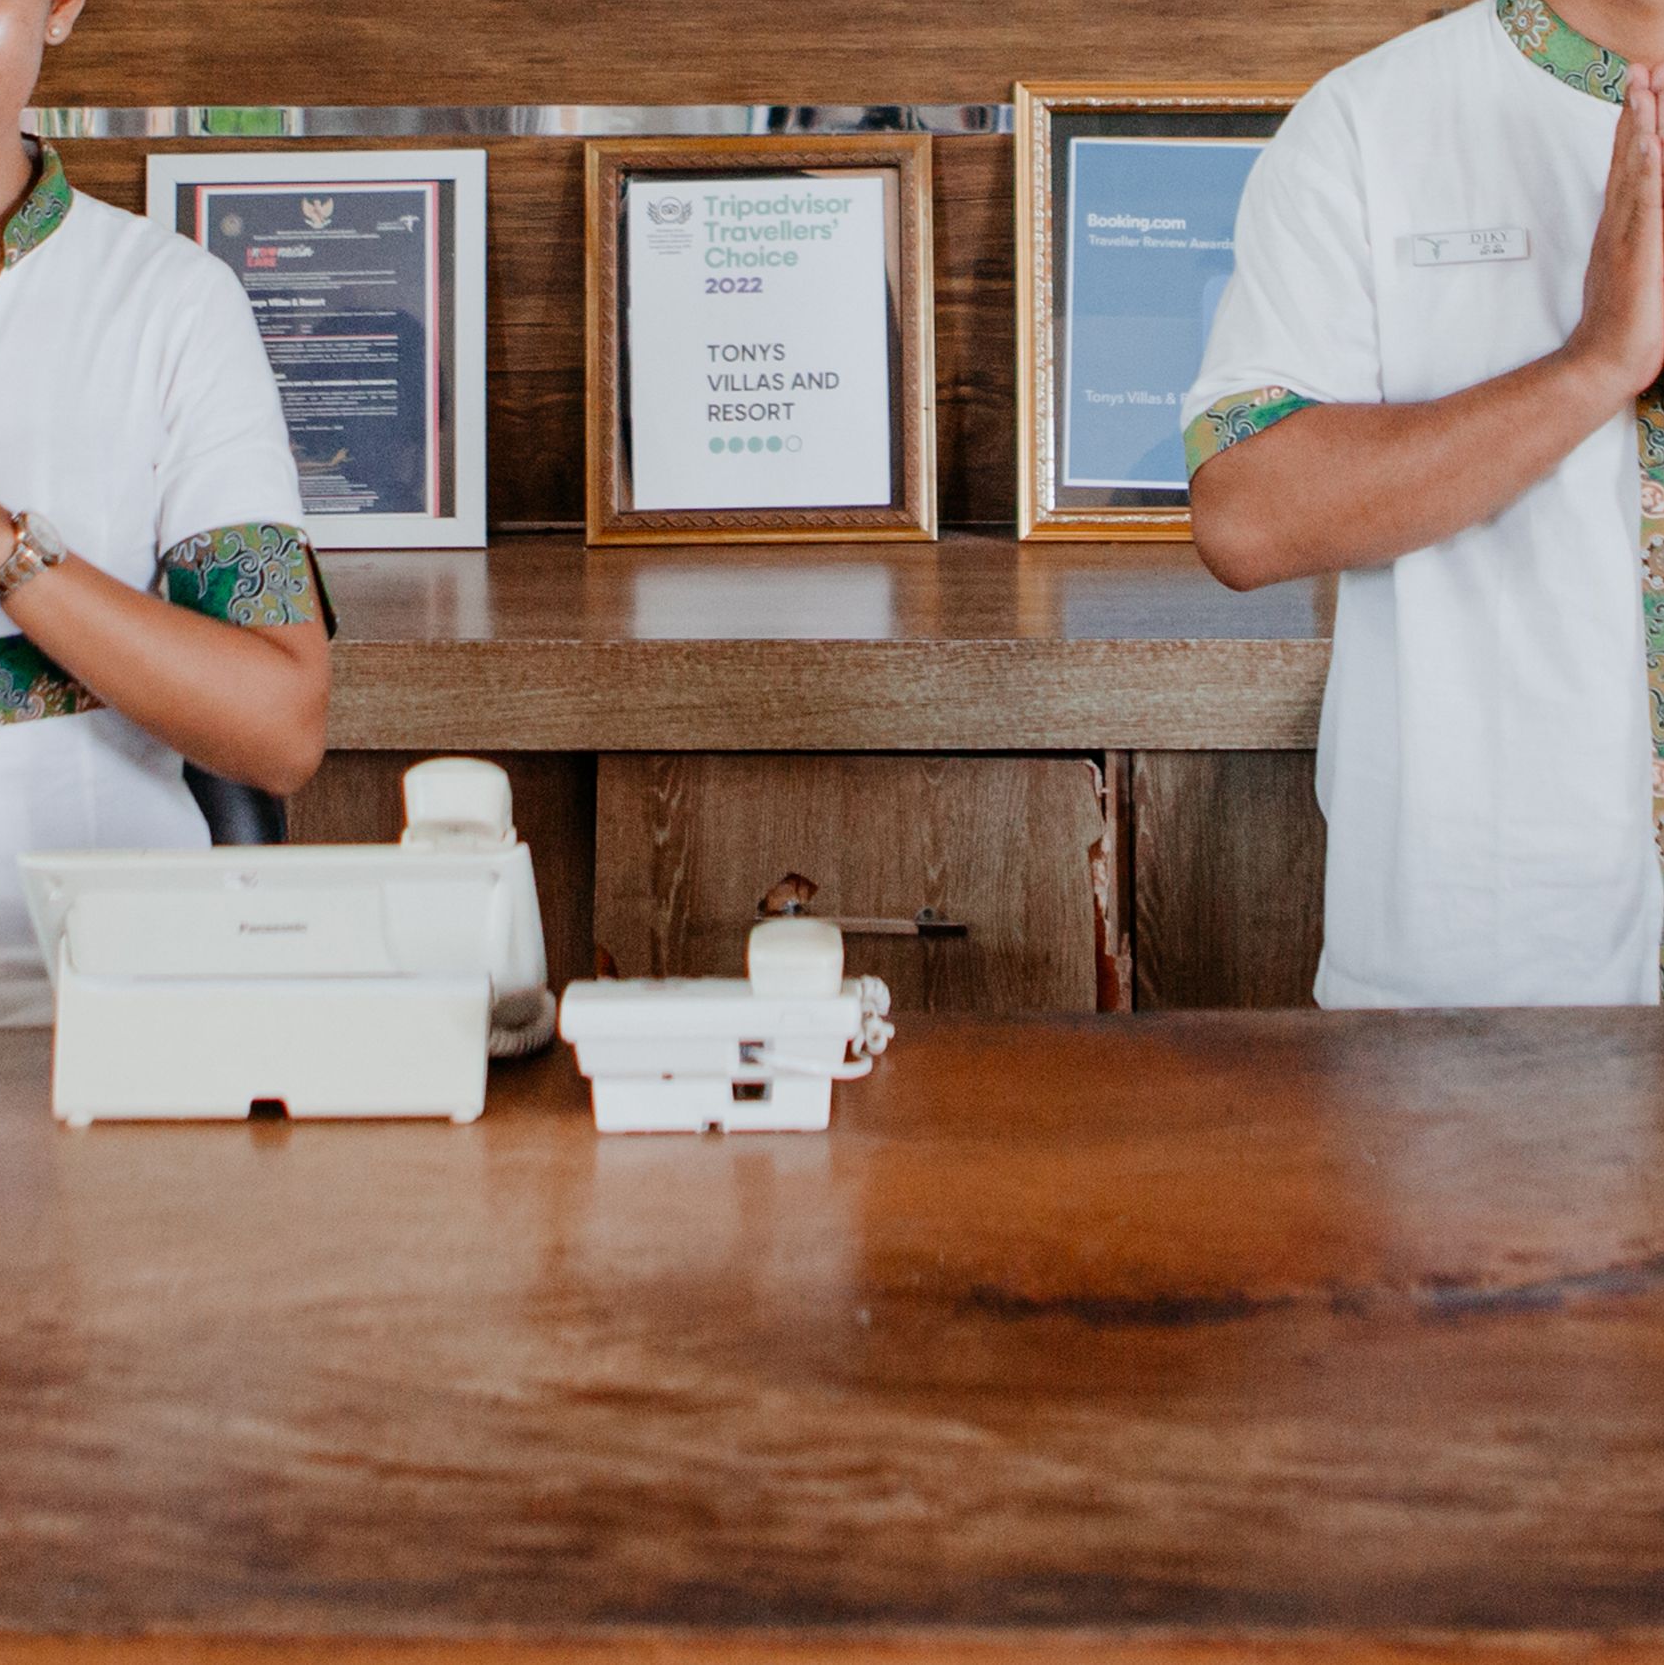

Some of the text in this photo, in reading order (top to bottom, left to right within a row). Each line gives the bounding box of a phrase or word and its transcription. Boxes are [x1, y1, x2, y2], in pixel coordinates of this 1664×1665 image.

[703, 192, 853, 220] Tripadvisor
[704, 219, 839, 242] Travellers'
[1086, 212, 1187, 232] Booking.com
[1088, 234, 1141, 249] Traveller
[1143, 235, 1188, 249] Review
[704, 246, 799, 269] Choice
[705, 277, 763, 294] 2022
[707, 343, 786, 363] TONYS
[707, 372, 840, 393] VILLAS AND
[1085, 389, 1125, 406] Tonys
[1126, 390, 1163, 405] Villas
[1165, 391, 1177, 405] &
[707, 402, 796, 422] RESORT
[239, 920, 307, 934] Panasonic
